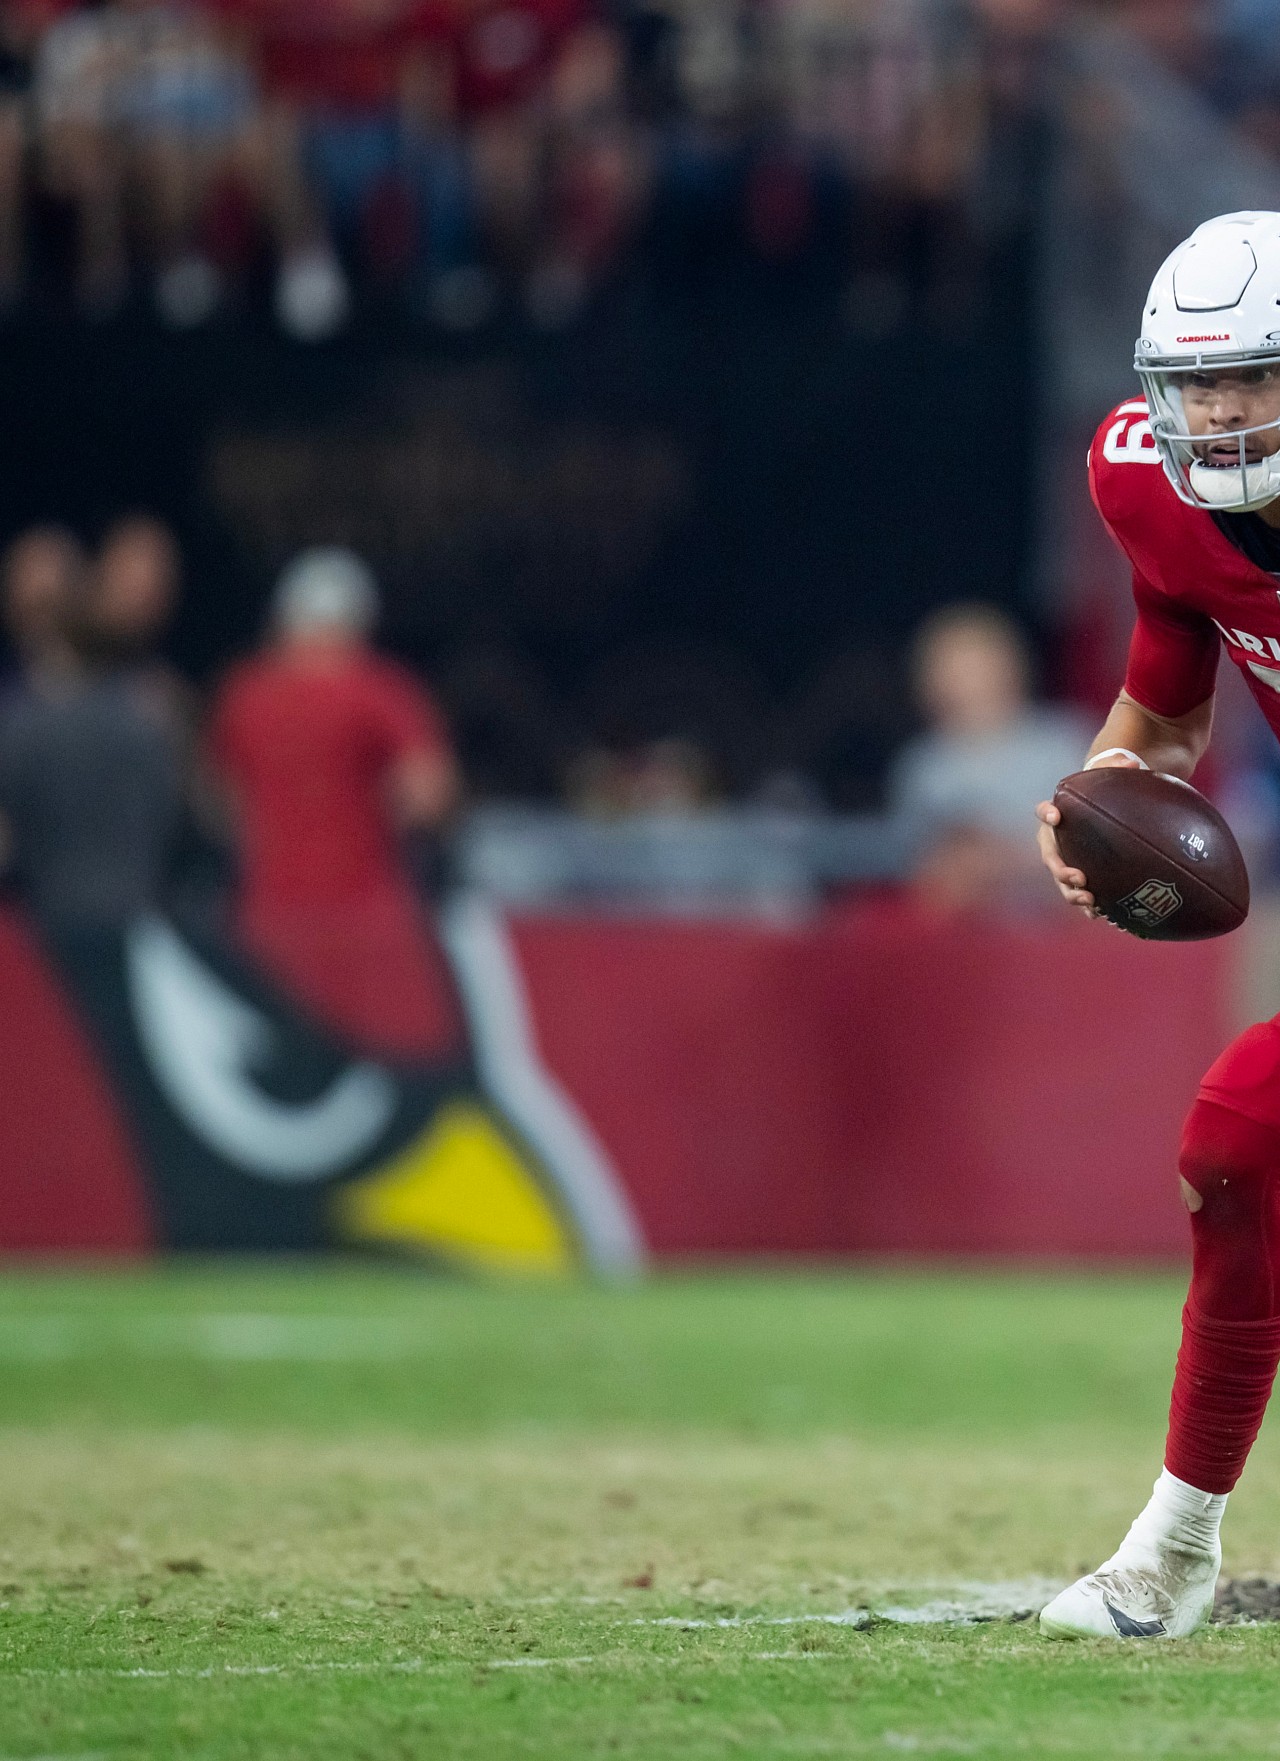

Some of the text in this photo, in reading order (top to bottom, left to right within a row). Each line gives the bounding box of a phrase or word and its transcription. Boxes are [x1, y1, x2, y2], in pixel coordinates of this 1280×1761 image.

[1176, 334, 1230, 343] CARDINALS
[1187, 833, 1204, 851] 087
[1139, 885, 1174, 916] NFL
